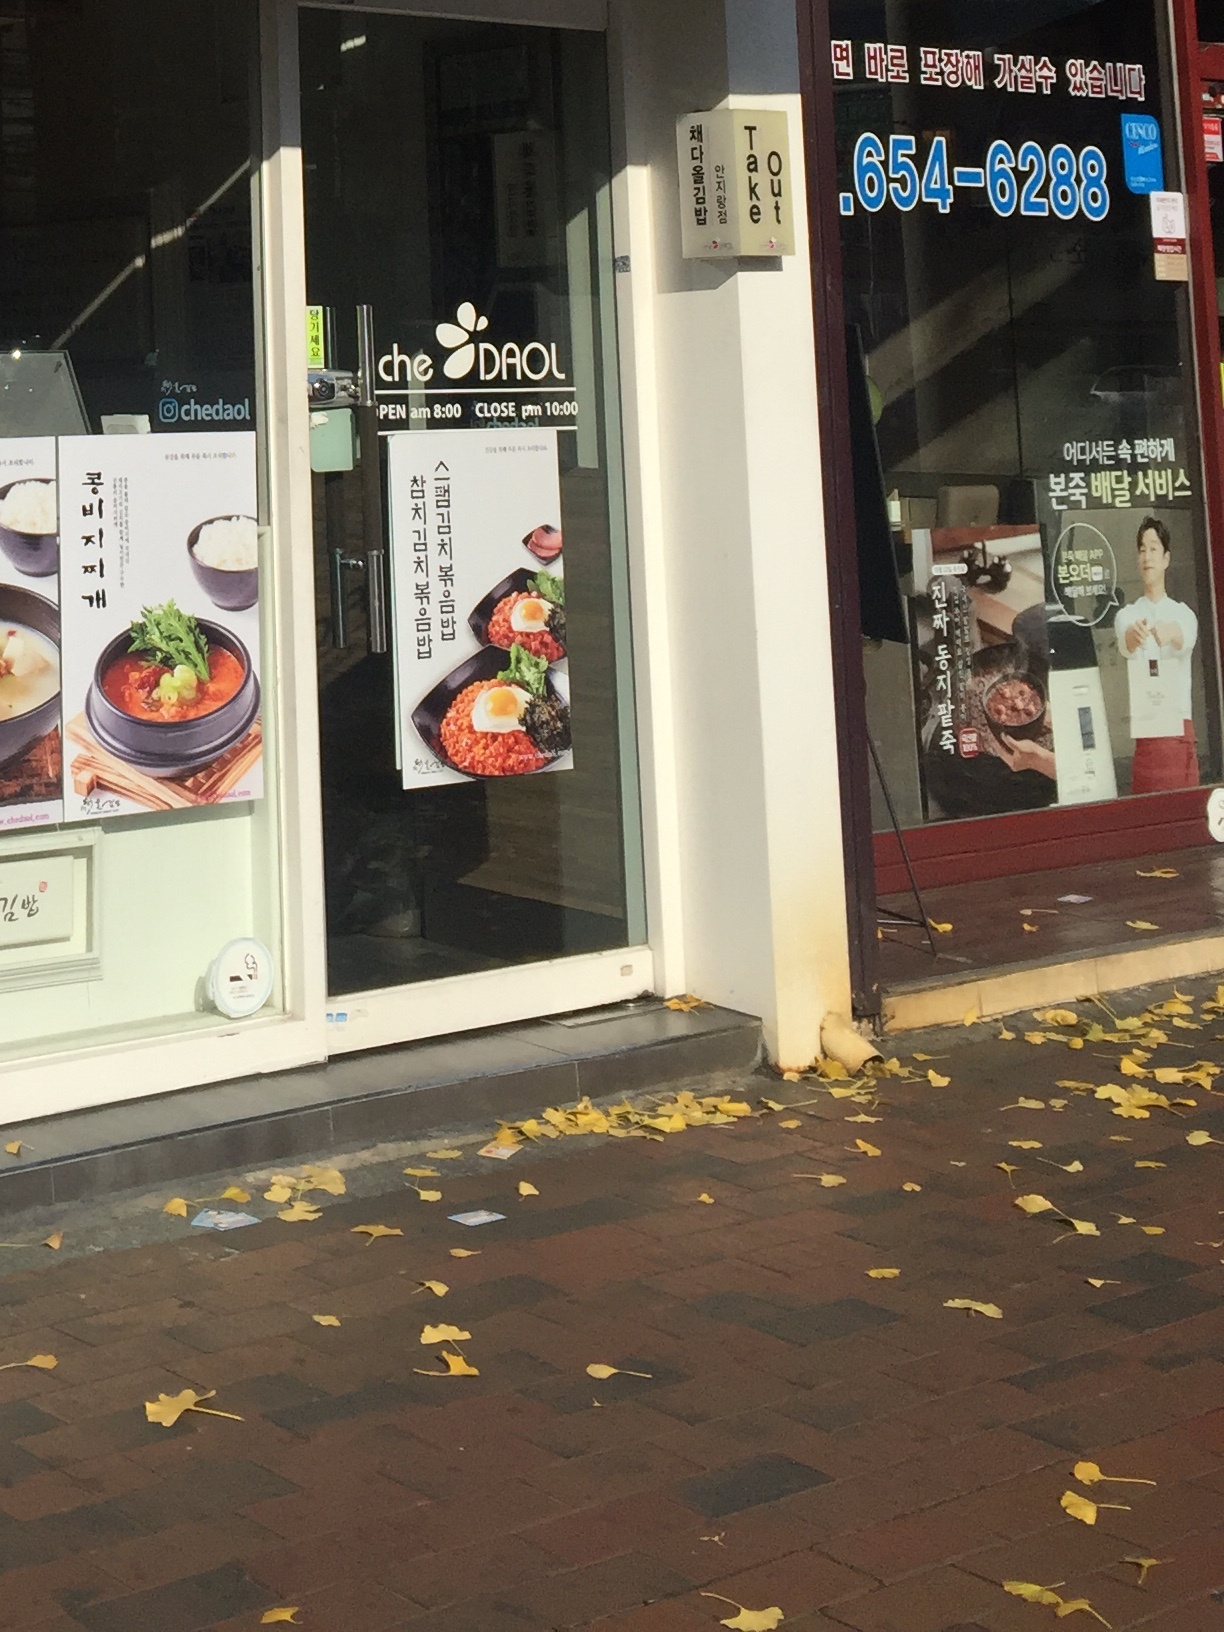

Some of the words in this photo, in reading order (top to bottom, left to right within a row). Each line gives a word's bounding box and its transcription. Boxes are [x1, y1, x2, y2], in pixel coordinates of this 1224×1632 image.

[864, 42, 909, 84] 바로
[920, 46, 985, 90] 포장해
[994, 54, 1057, 95] 가실수
[1065, 58, 1145, 101] 있습니다
[1125, 121, 1158, 141] CESCO
[689, 124, 708, 226] 채다올김밥
[714, 164, 727, 225] 안지랑점
[743, 125, 762, 225] Take
[767, 150, 782, 225] Out
[309, 309, 321, 357] 당기세요
[378, 343, 434, 382] che
[478, 341, 566, 382] DAOL
[181, 398, 251, 421] chedaol
[376, 403, 407, 420] PEN
[410, 406, 431, 419] am
[433, 403, 462, 419] 8:00
[475, 402, 516, 418] CLOSE
[521, 405, 542, 420] pm
[545, 401, 579, 416] 10:00
[1063, 440, 1116, 465] 어디서든
[1117, 438, 1132, 463] 속
[1134, 437, 1176, 463] 편하게
[1048, 472, 1088, 510] 본죽
[1090, 469, 1132, 508] 배달
[1135, 468, 1192, 502] 서비스
[81, 471, 107, 609] 콩비지찌개
[410, 474, 432, 660] 참치김치볶음밥
[433, 460, 456, 641] 스팸김치볶음밥
[1057, 563, 1092, 584] 본오더
[932, 581, 950, 637] 진짜
[935, 644, 957, 755] 동지팥죽
